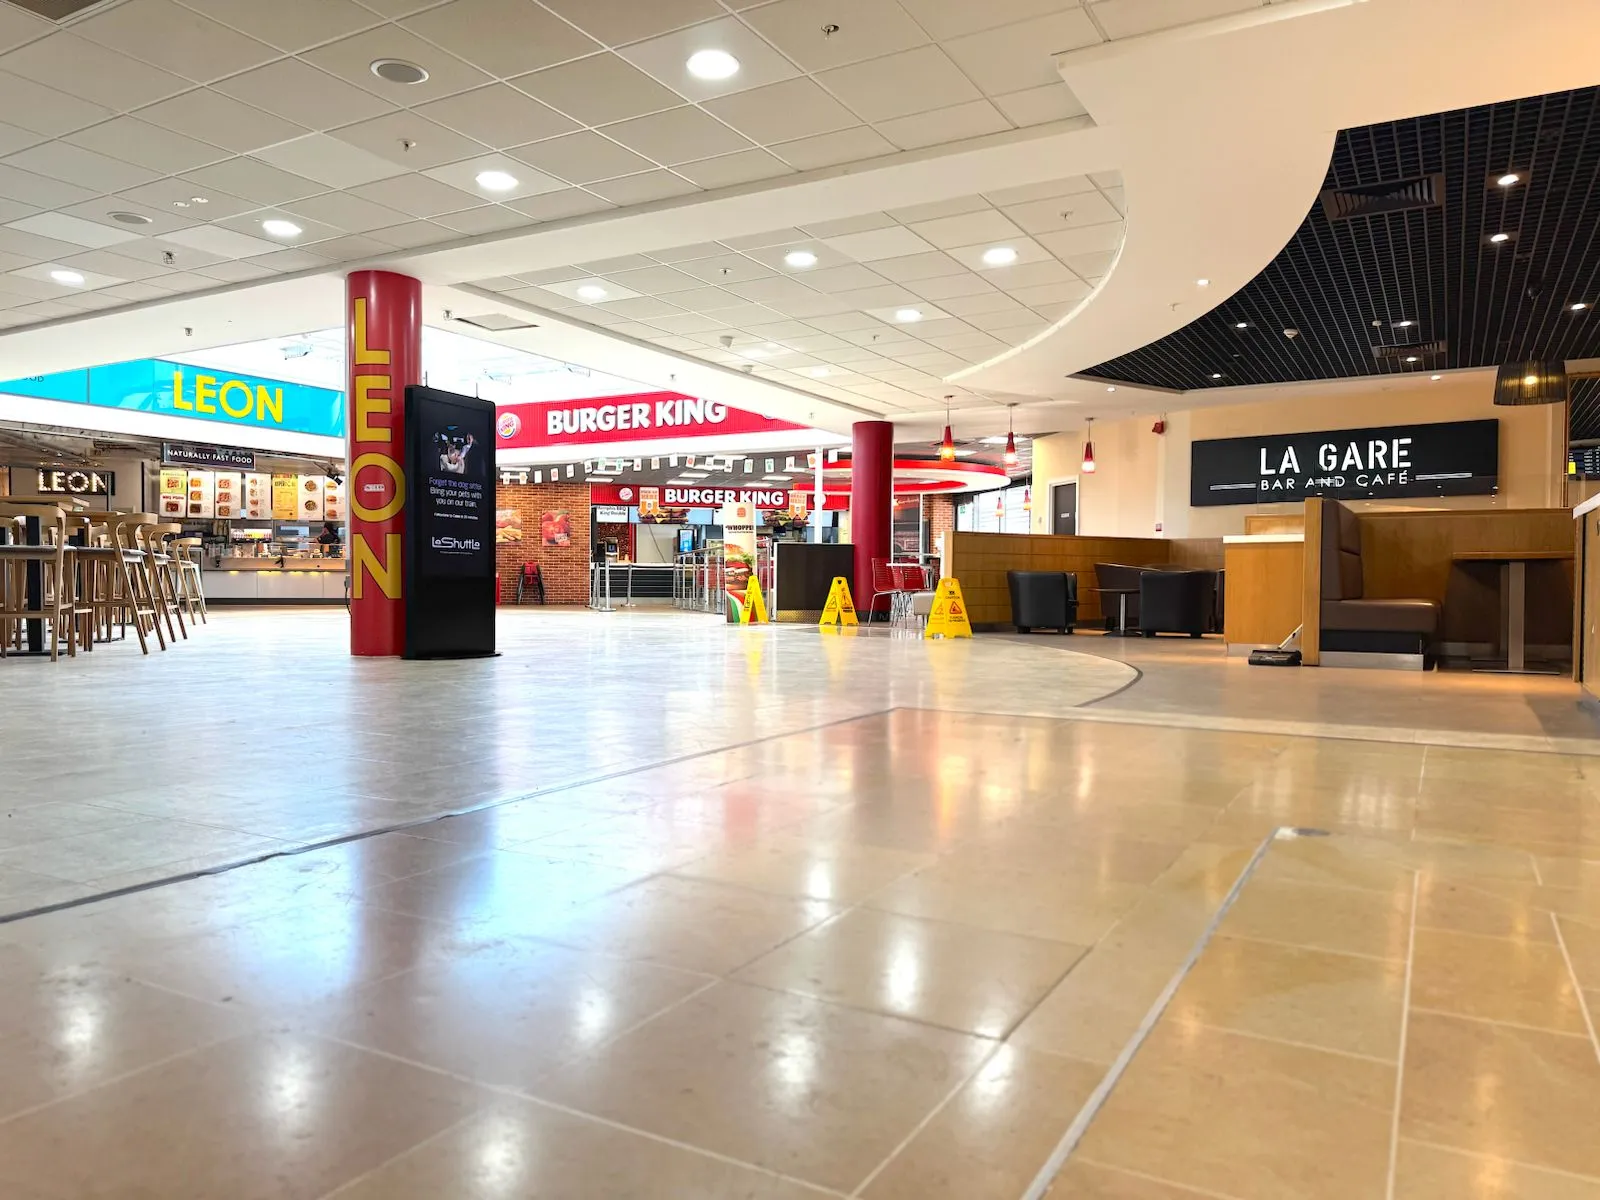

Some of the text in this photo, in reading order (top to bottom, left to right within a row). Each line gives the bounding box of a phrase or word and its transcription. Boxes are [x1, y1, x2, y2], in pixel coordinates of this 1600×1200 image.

[173, 371, 283, 424] LEON
[547, 399, 727, 436] BURGER KING
[167, 449, 253, 464] NATURALLY FAST FOOD
[350, 297, 406, 600] LEON
[1260, 437, 1412, 476] LA GARE
[38, 468, 108, 493] LEON
[1260, 470, 1409, 491] BAR AND CAFÉ
[664, 488, 784, 505] BURGER KING
